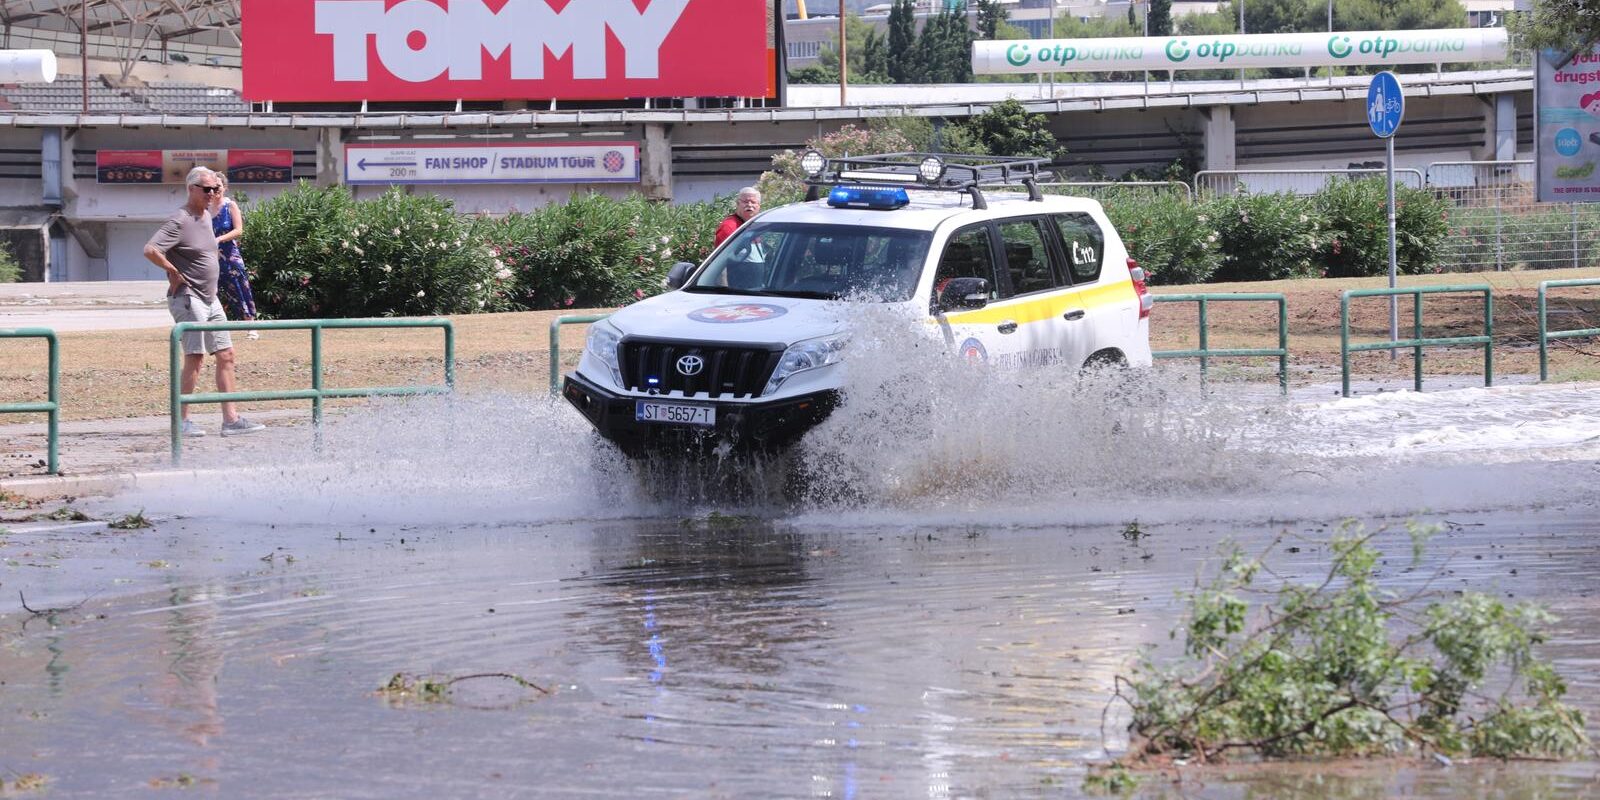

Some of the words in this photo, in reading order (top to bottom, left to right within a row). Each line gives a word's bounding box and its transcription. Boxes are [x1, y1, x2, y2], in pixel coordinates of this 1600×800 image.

[314, 0, 690, 82] TOMMY
[425, 157, 450, 169] FAN
[453, 157, 488, 169] SHOP
[500, 157, 558, 169] STADIUM
[561, 156, 596, 168] TOUR
[390, 168, 406, 177] 200
[1081, 246, 1096, 263] 112
[645, 404, 660, 419] ST
[668, 406, 710, 422] 5657-T
